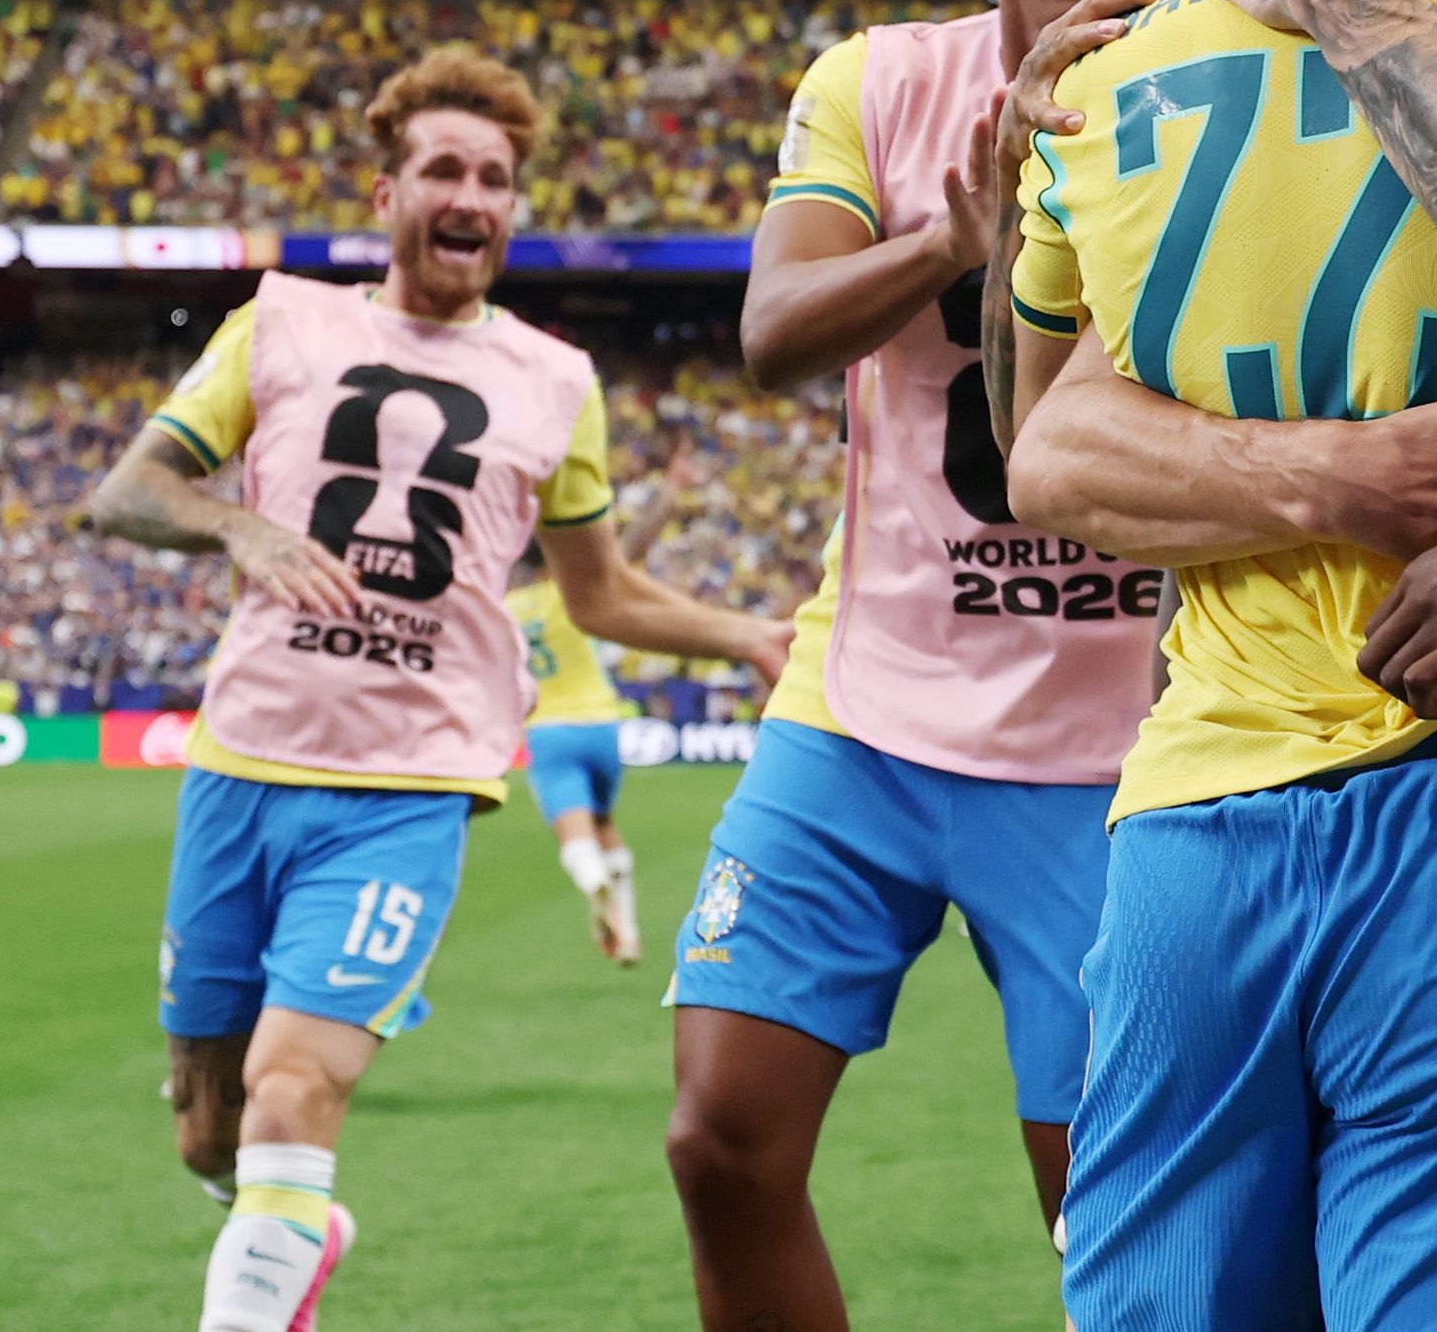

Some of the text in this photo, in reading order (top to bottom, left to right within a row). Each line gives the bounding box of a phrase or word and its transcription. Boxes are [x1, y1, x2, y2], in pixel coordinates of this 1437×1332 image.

[345, 541, 416, 581] FIFA
[943, 538, 1087, 567] WORLD
[952, 569, 1164, 621] 2026
[289, 621, 434, 672] 2026
[392, 613, 443, 637] CUP
[343, 879, 425, 965] 15
